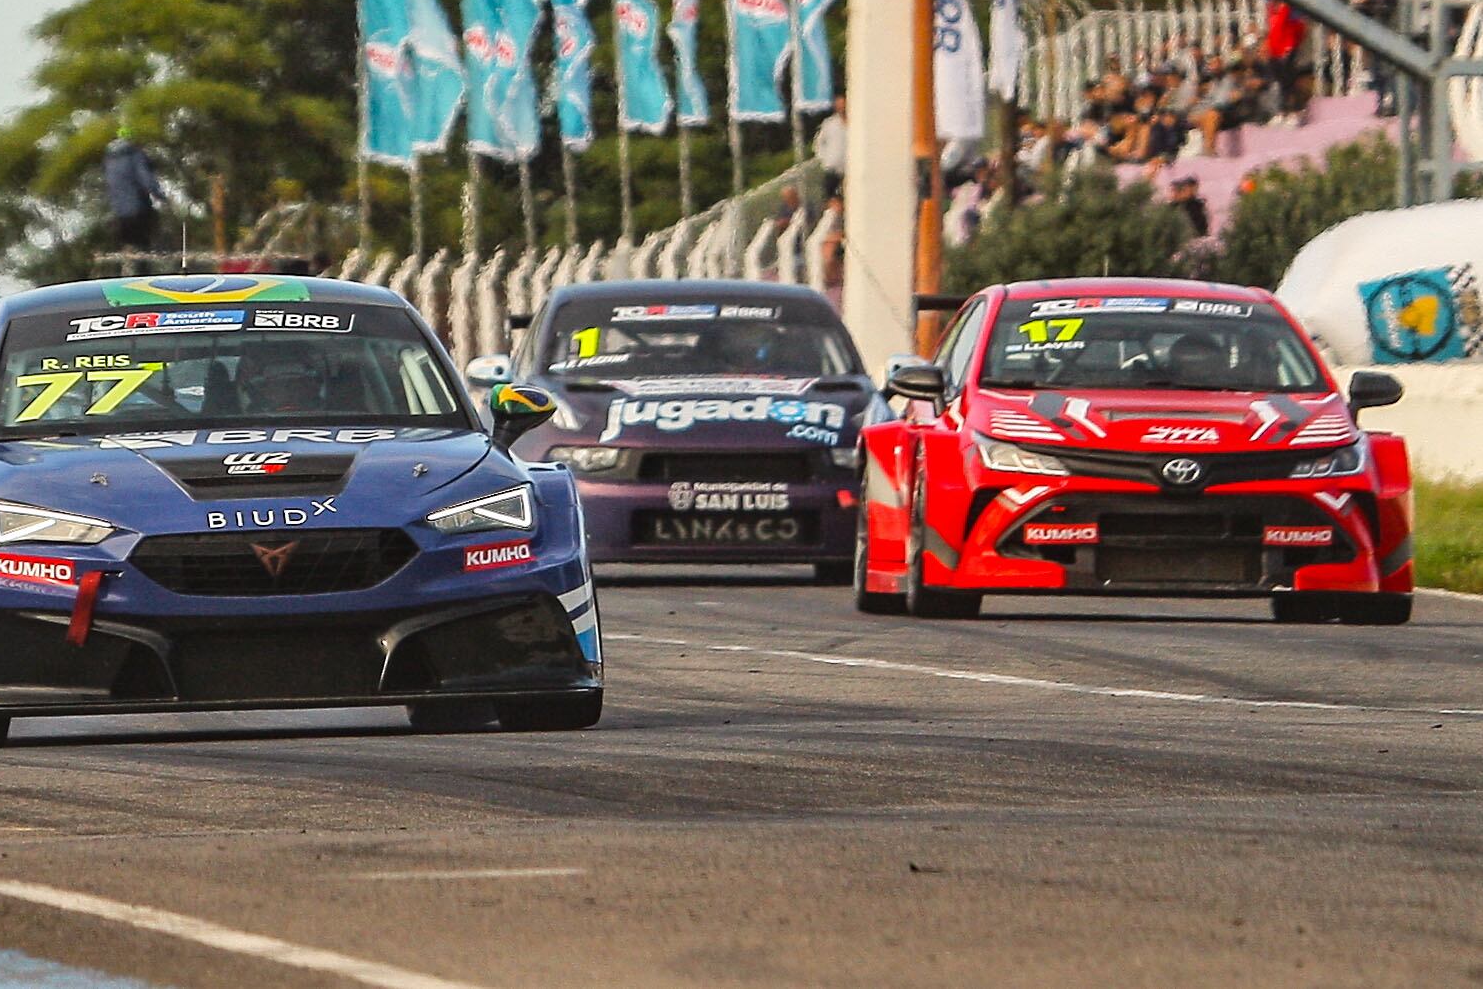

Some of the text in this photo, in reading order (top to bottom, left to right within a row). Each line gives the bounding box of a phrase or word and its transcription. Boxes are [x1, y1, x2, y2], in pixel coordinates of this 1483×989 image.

[69, 313, 159, 334] TCR
[284, 314, 340, 328] BRB
[1019, 318, 1083, 343] 17
[572, 327, 601, 358] 1
[42, 355, 130, 370] R. REIS
[15, 370, 154, 423] 77
[599, 396, 845, 443] jugadon
[206, 429, 396, 444] BRB
[695, 494, 789, 509] SAN LUIS
[1026, 527, 1096, 541] KUMHO
[1266, 529, 1332, 542] KUMHO
[466, 544, 531, 566] KUMHO
